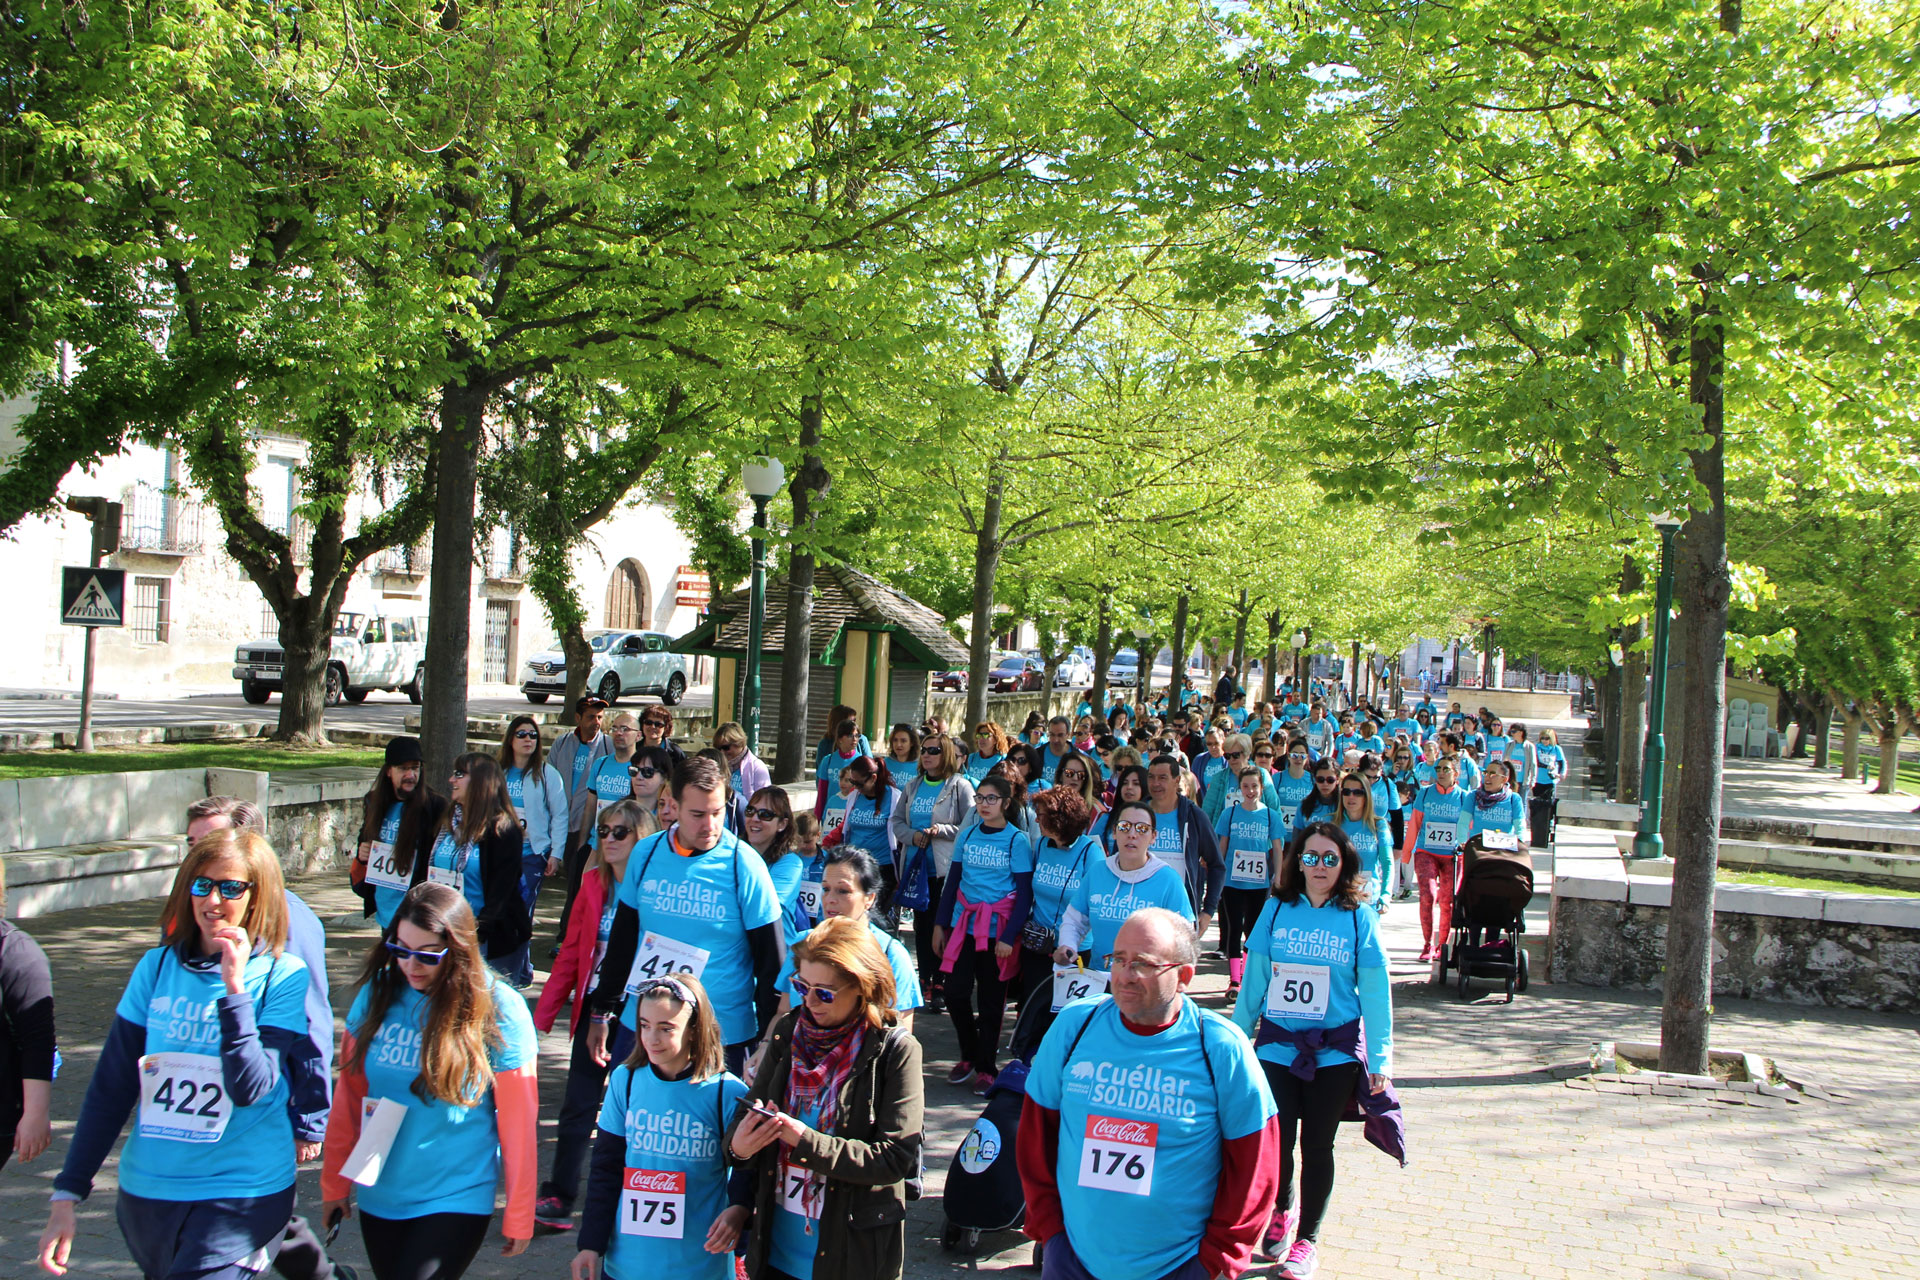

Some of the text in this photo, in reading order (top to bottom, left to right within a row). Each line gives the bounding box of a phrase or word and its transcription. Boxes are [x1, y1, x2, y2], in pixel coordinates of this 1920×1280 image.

[600, 784, 630, 794] SOLIDARI
[602, 775, 629, 785] Cuélla
[913, 804, 933, 813] SOLID
[915, 796, 935, 805] Cuél
[1428, 830, 1453, 842] 473
[968, 844, 1009, 858] Cuéllar
[1236, 859, 1263, 874] 415
[656, 878, 723, 903] Cuéllar
[654, 895, 727, 919] SOLIDARIO
[1100, 906, 1130, 920] SOLID
[1288, 928, 1348, 949] Cuéllar
[1286, 941, 1350, 964] SOLIDARIO
[1066, 981, 1090, 999] 64
[1283, 979, 1314, 1004] 50
[166, 1019, 221, 1044] SOLID
[1095, 1061, 1191, 1097] Cuéllar
[153, 1077, 223, 1118] 422
[1092, 1084, 1197, 1118] SOLIDARIO
[634, 1108, 713, 1139] Cuéllar
[1093, 1118, 1150, 1144] Coca-Cola
[632, 1131, 718, 1158] SOLIDARIO
[1091, 1148, 1145, 1180] 176
[630, 1170, 679, 1191] Coca-Cola
[630, 1198, 677, 1226] 175
